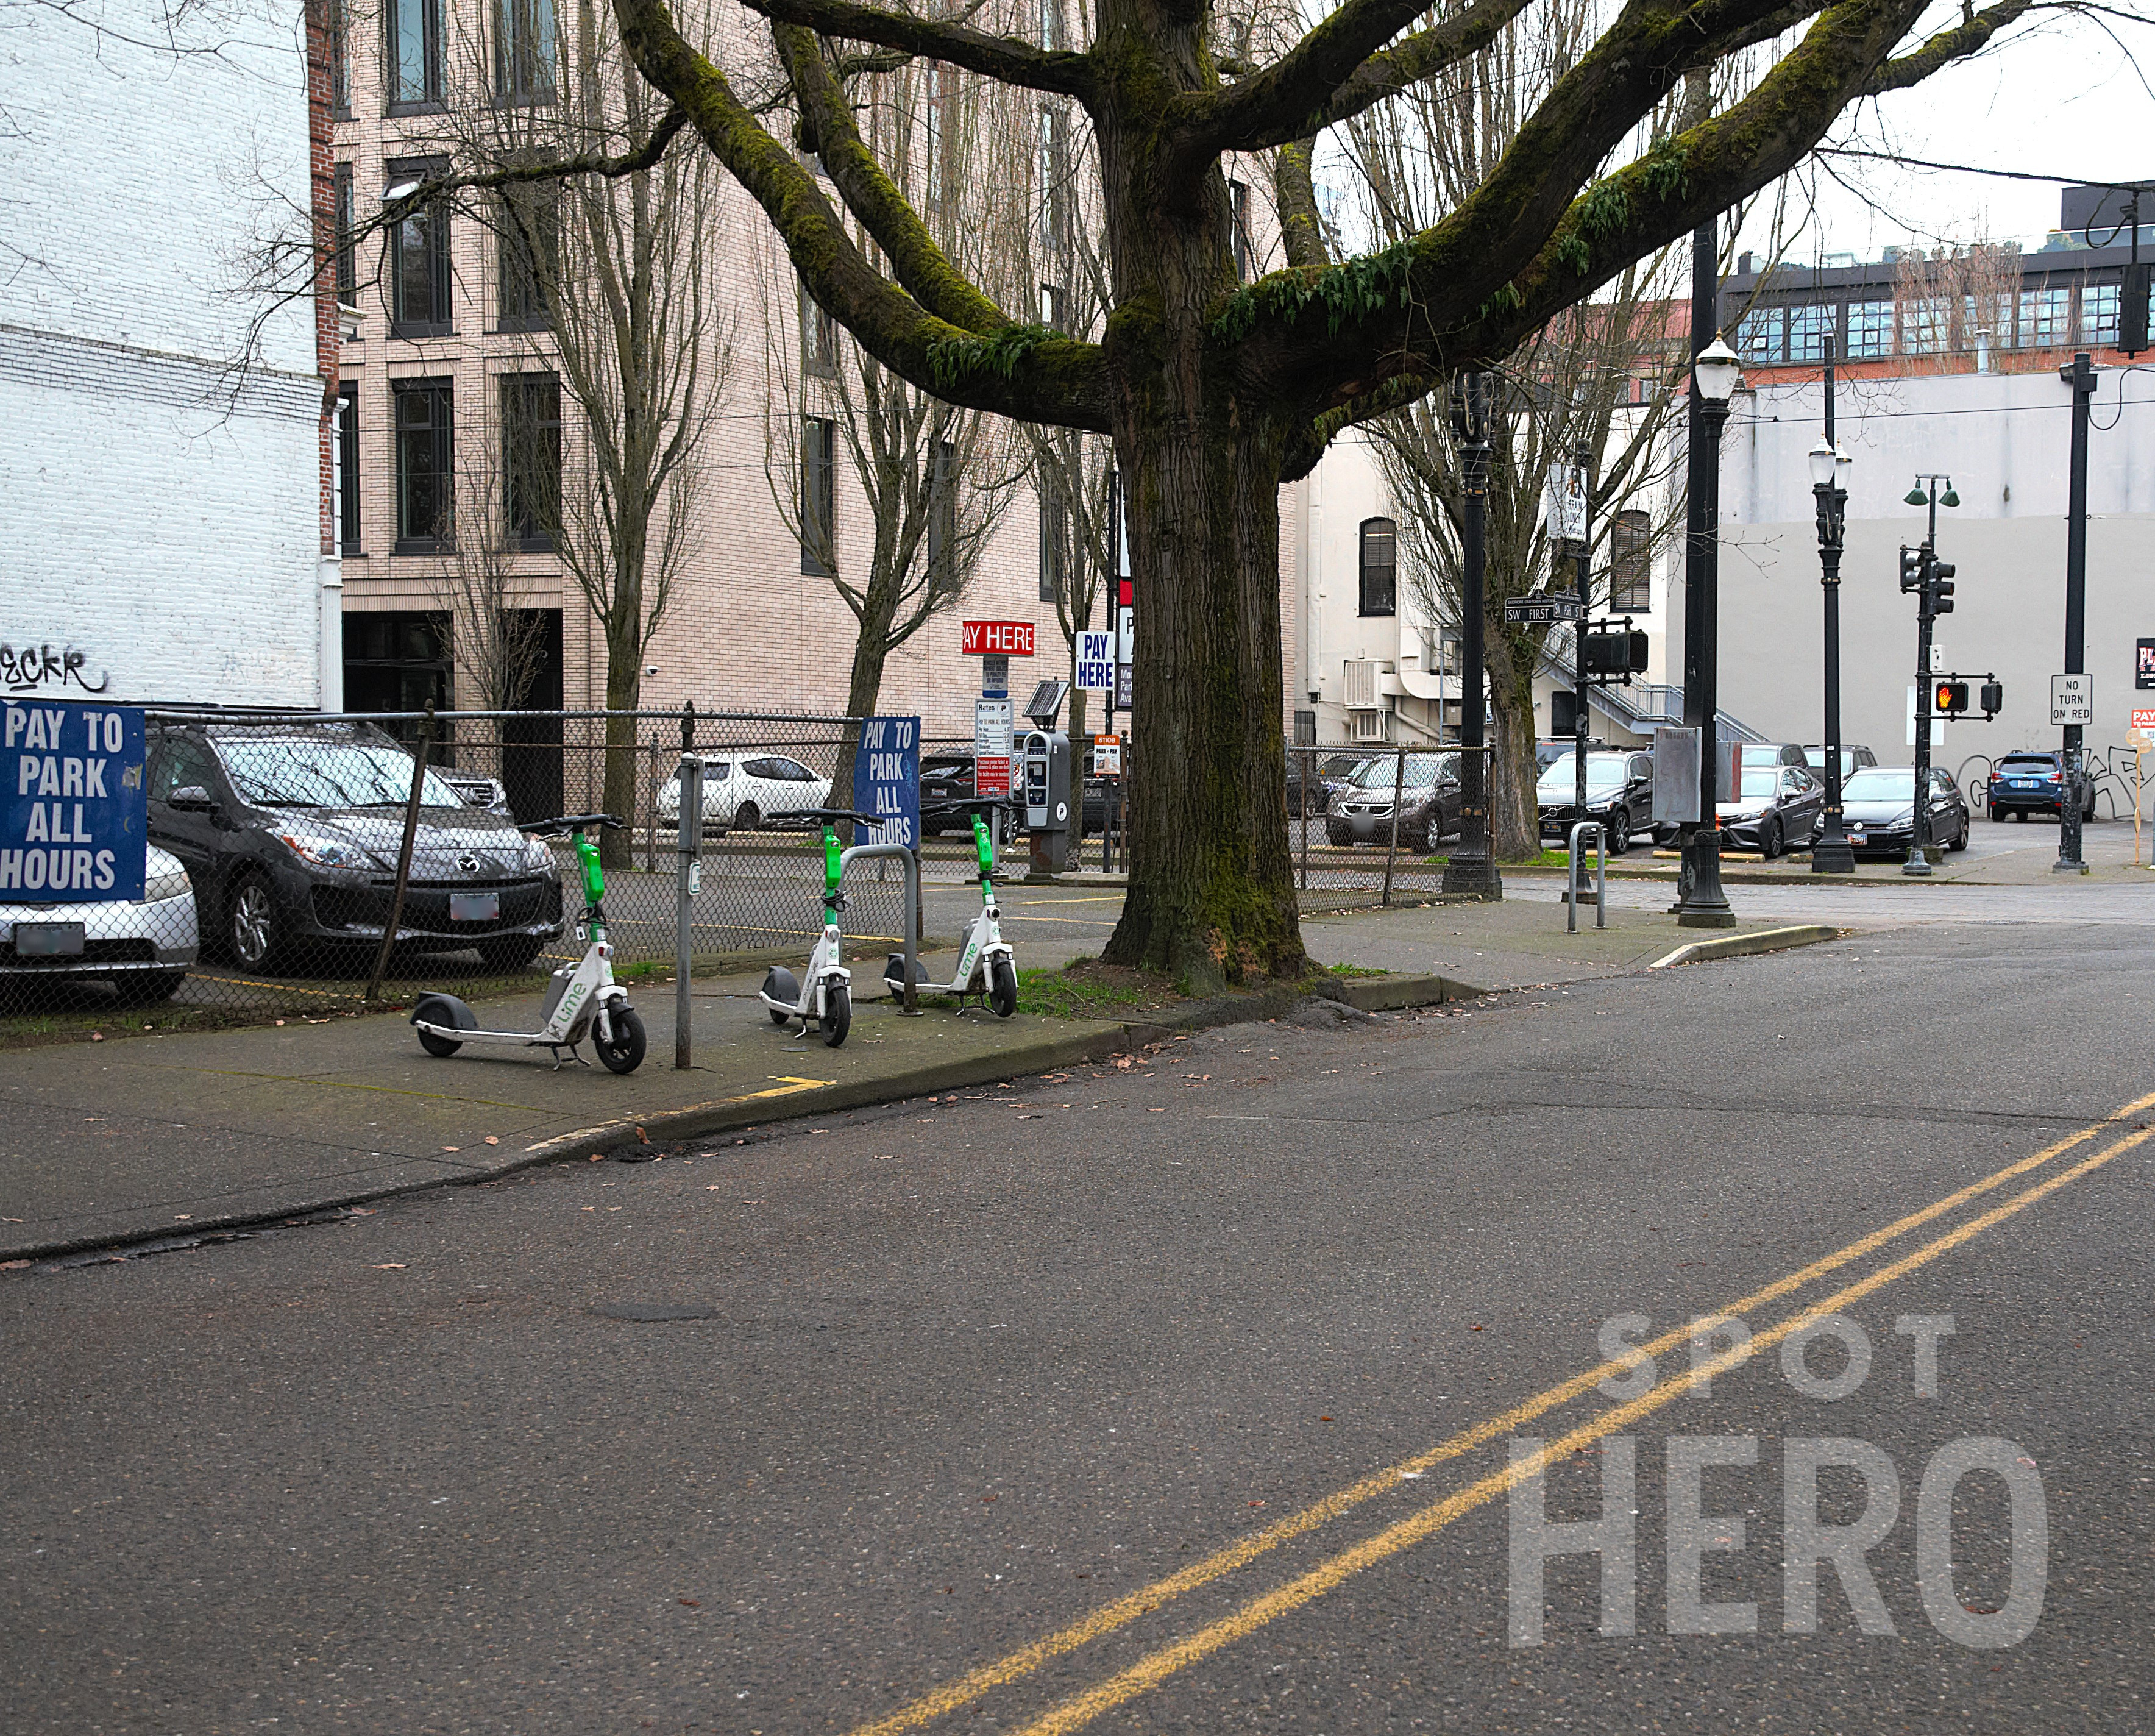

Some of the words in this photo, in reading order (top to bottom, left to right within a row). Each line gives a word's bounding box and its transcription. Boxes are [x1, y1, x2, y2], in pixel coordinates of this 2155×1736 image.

[1508, 609, 1521, 621] SW
[1529, 608, 1549, 619] FIRST
[987, 625, 1033, 650] HERE
[1084, 635, 1108, 660] PAY
[1078, 662, 1113, 687] HERE
[2066, 681, 2078, 690] NO
[2059, 695, 2083, 705] TURN
[2053, 710, 2065, 719] ON
[2072, 710, 2089, 719] RED
[2133, 711, 2155, 721] PAY
[5, 706, 66, 750] PAY
[83, 711, 123, 753] TO
[864, 722, 886, 749] PAY
[896, 722, 913, 749] TO
[18, 755, 108, 798] PARK
[870, 753, 903, 780] PARK
[876, 786, 901, 814] ALL
[26, 802, 92, 842] ALL
[868, 817, 911, 845] HOURS
[0, 849, 115, 890] HOURS
